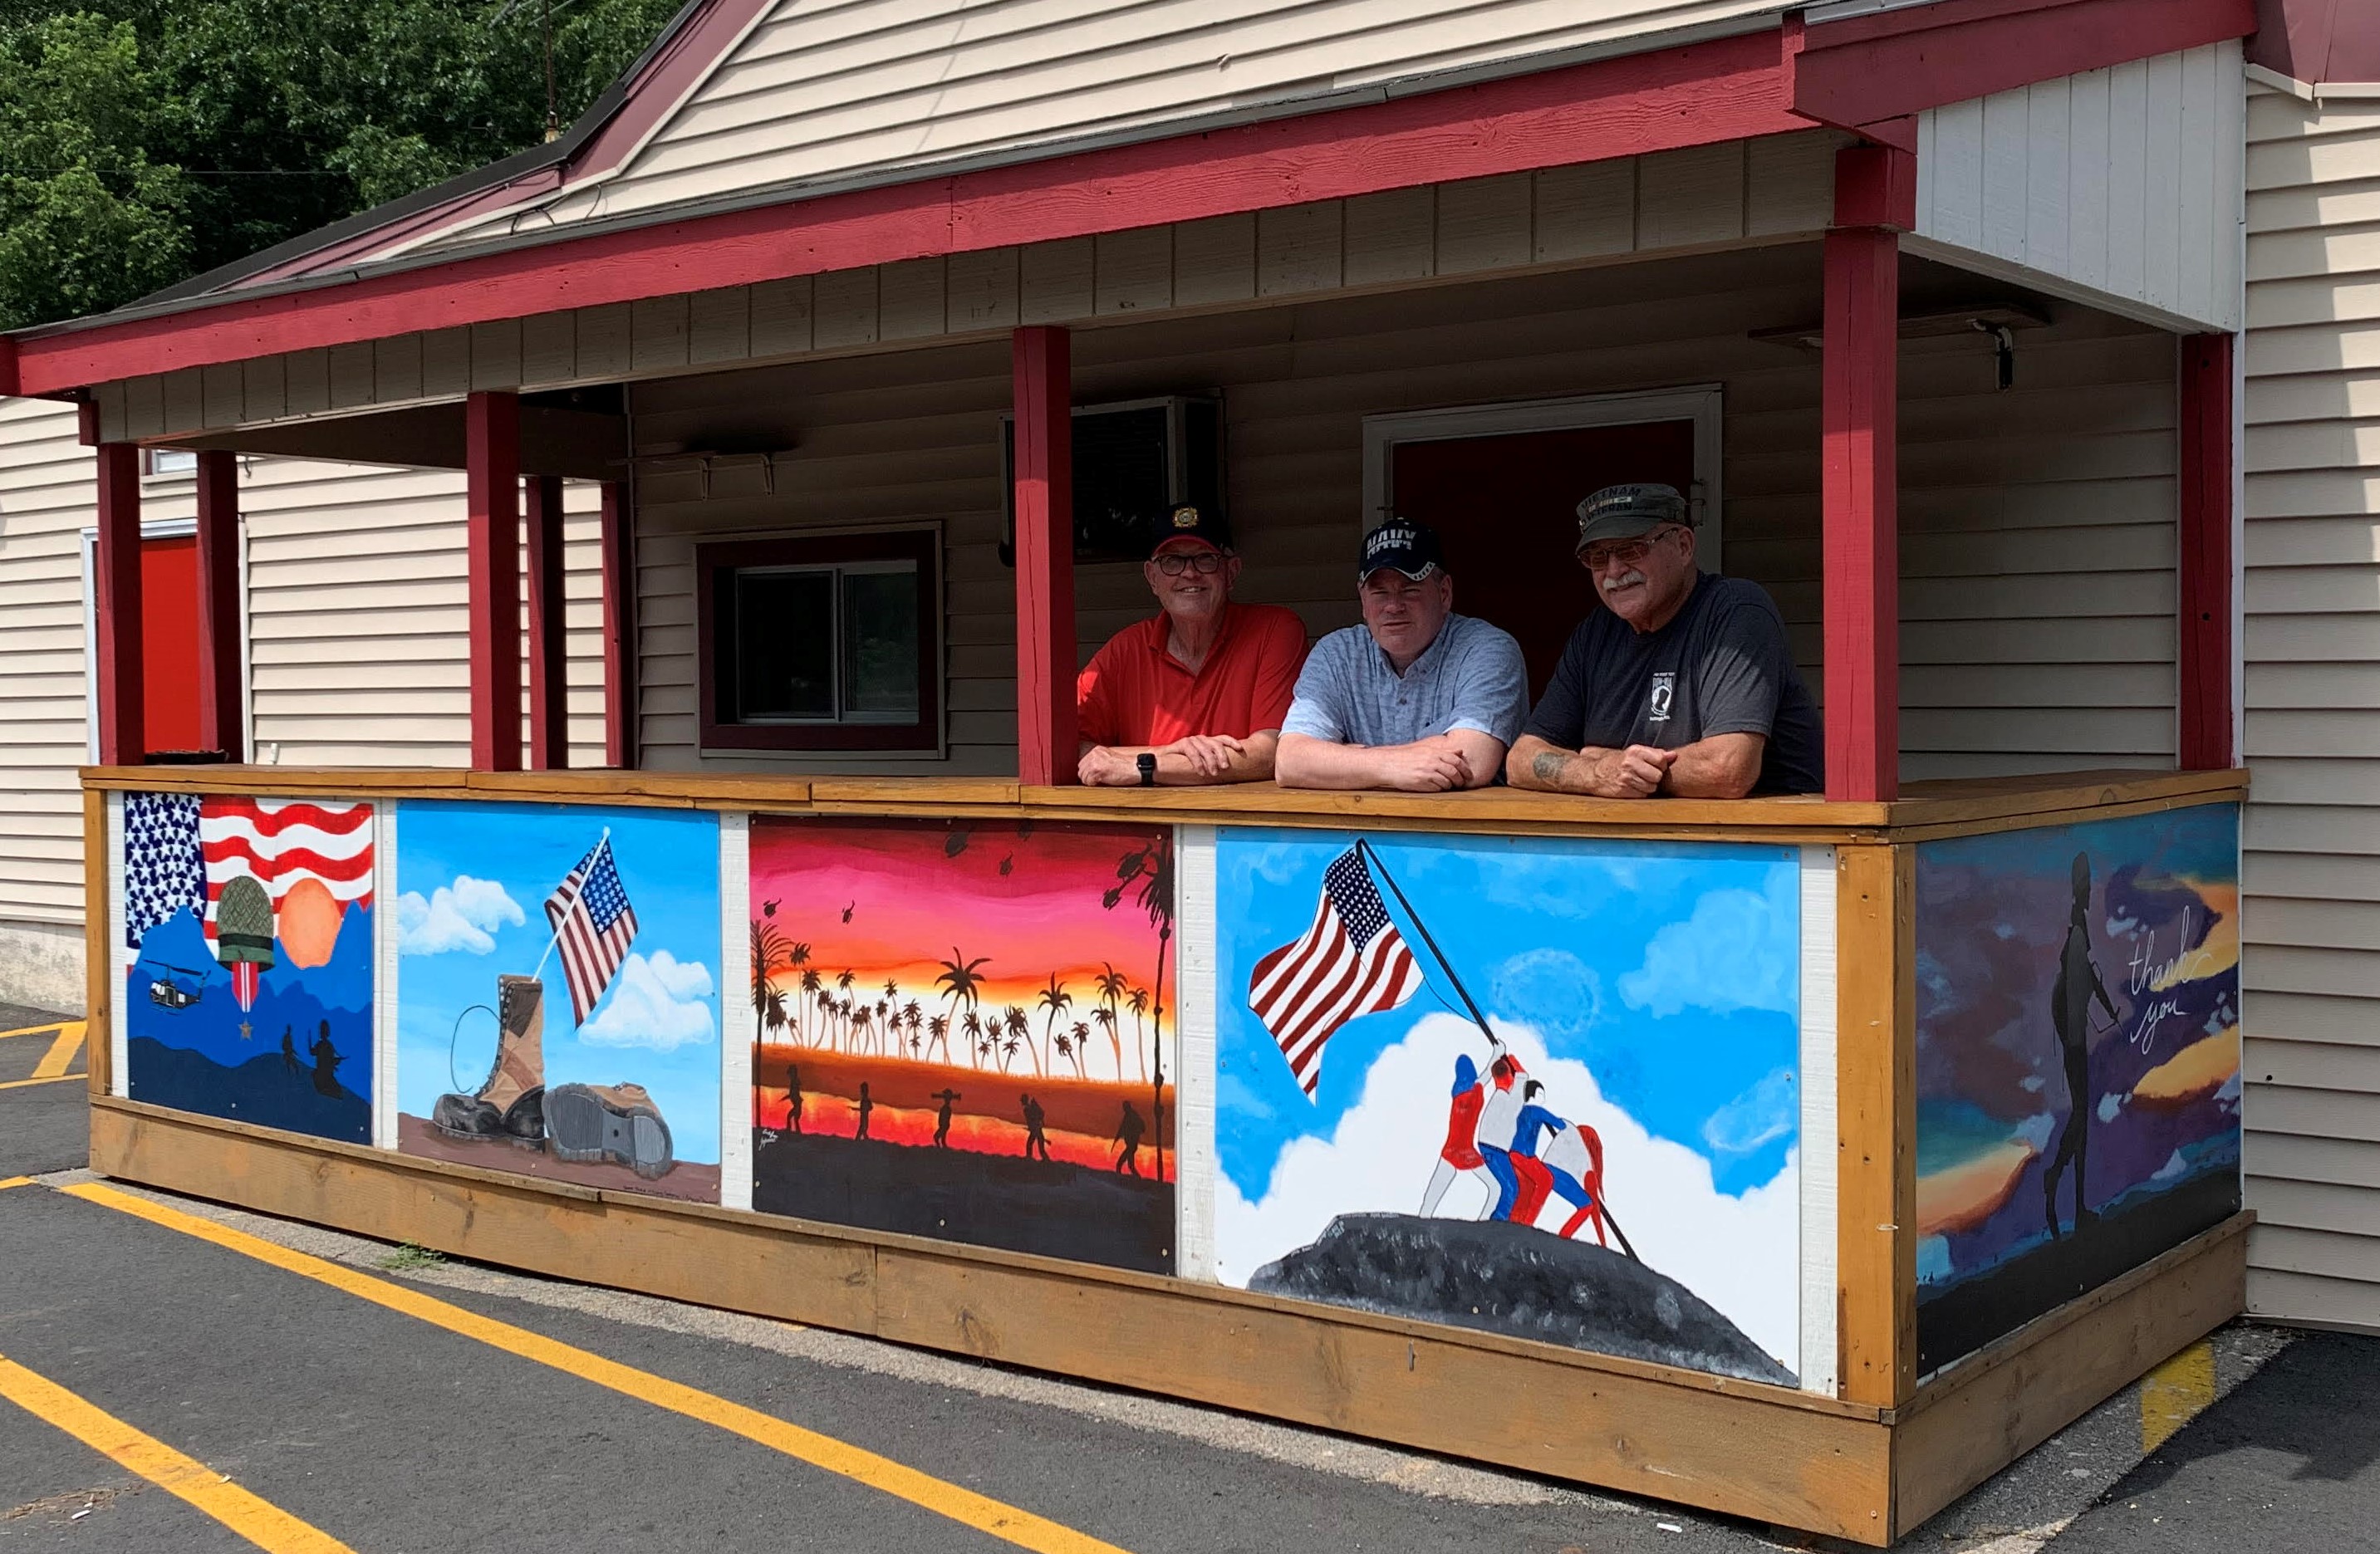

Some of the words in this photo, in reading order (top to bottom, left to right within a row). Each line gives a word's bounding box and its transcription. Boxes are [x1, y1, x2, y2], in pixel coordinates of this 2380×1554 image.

[1581, 486, 1641, 508] VIETNAM
[1586, 502, 1633, 522] VETERAN
[1367, 528, 1417, 560] NAVY
[2128, 904, 2212, 996] thank
[2129, 997, 2191, 1056] you
